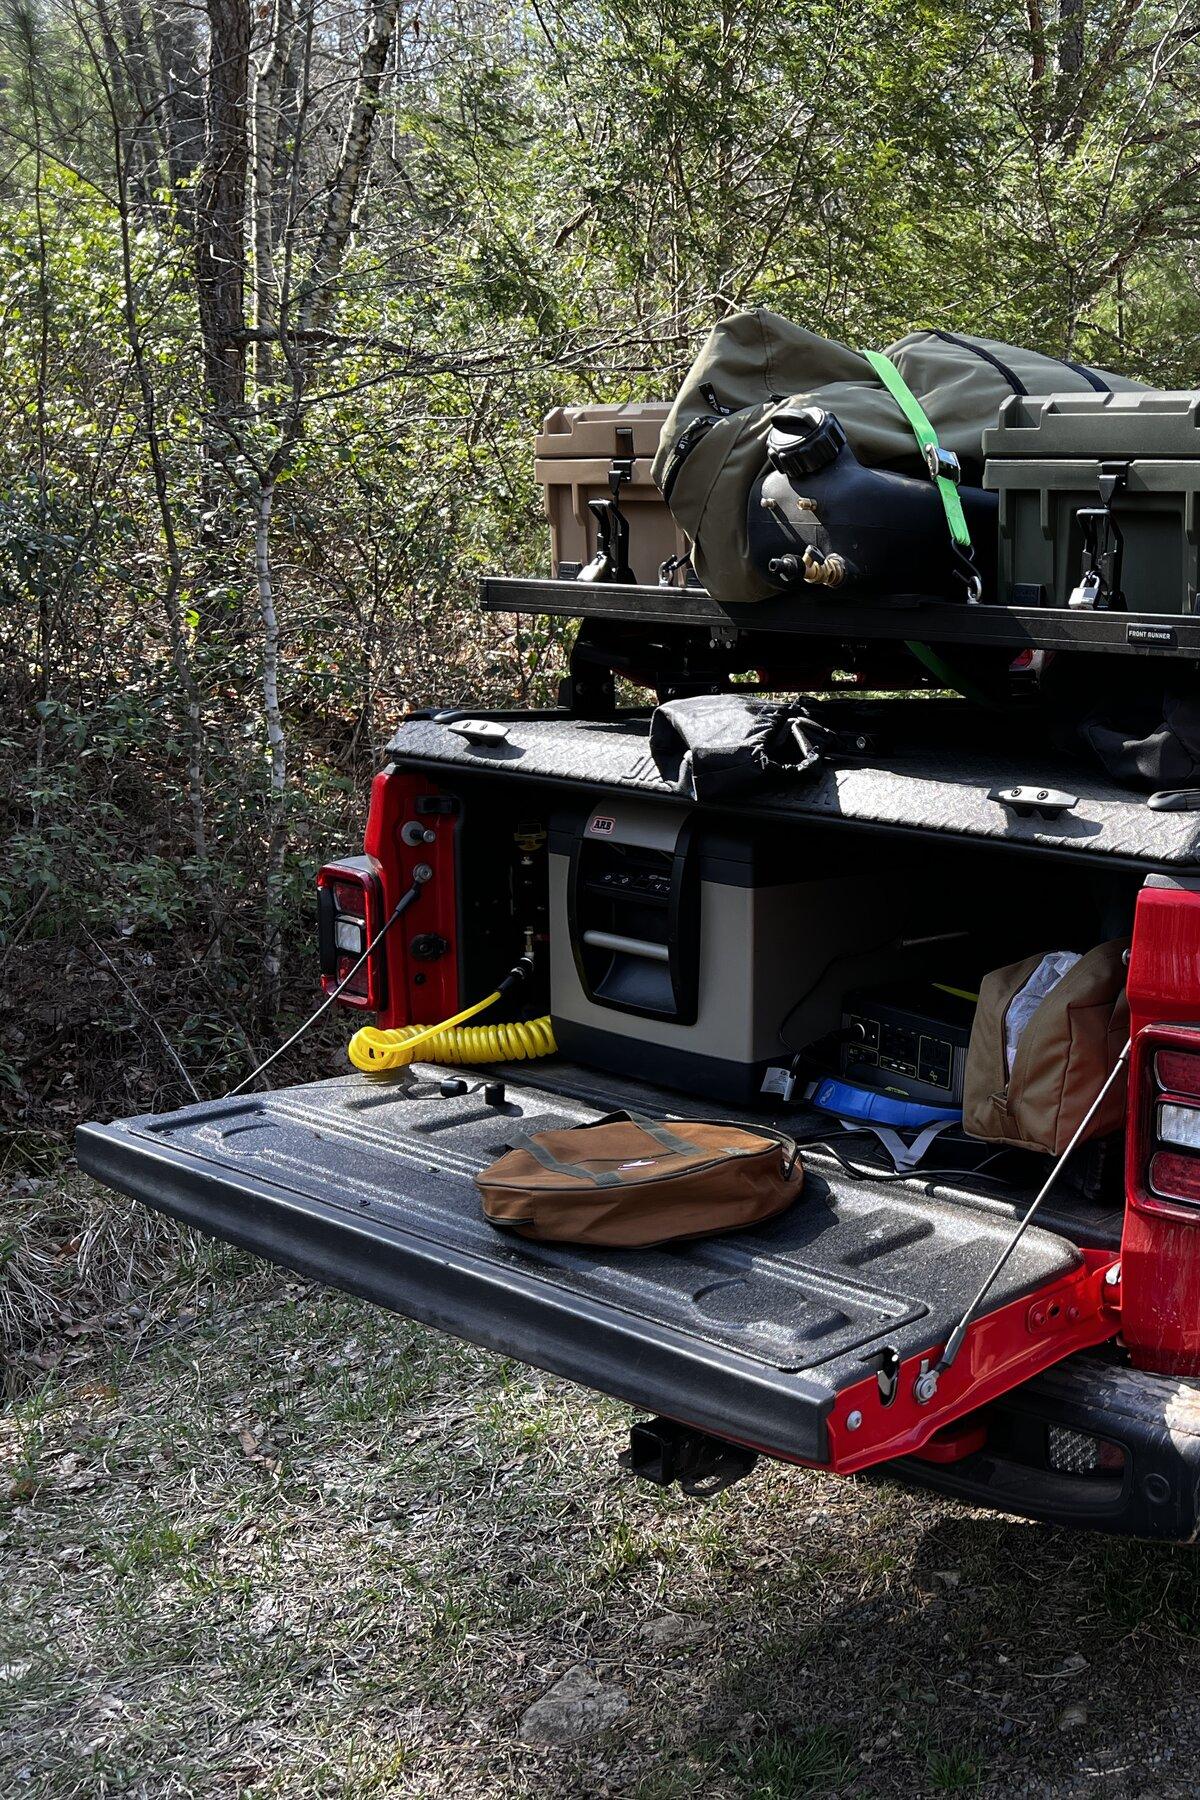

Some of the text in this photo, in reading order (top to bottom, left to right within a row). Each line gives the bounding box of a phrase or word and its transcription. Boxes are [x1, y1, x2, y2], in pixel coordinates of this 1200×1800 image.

[1128, 630, 1171, 640] FRONT RUNNER
[593, 820, 612, 830] ARB
